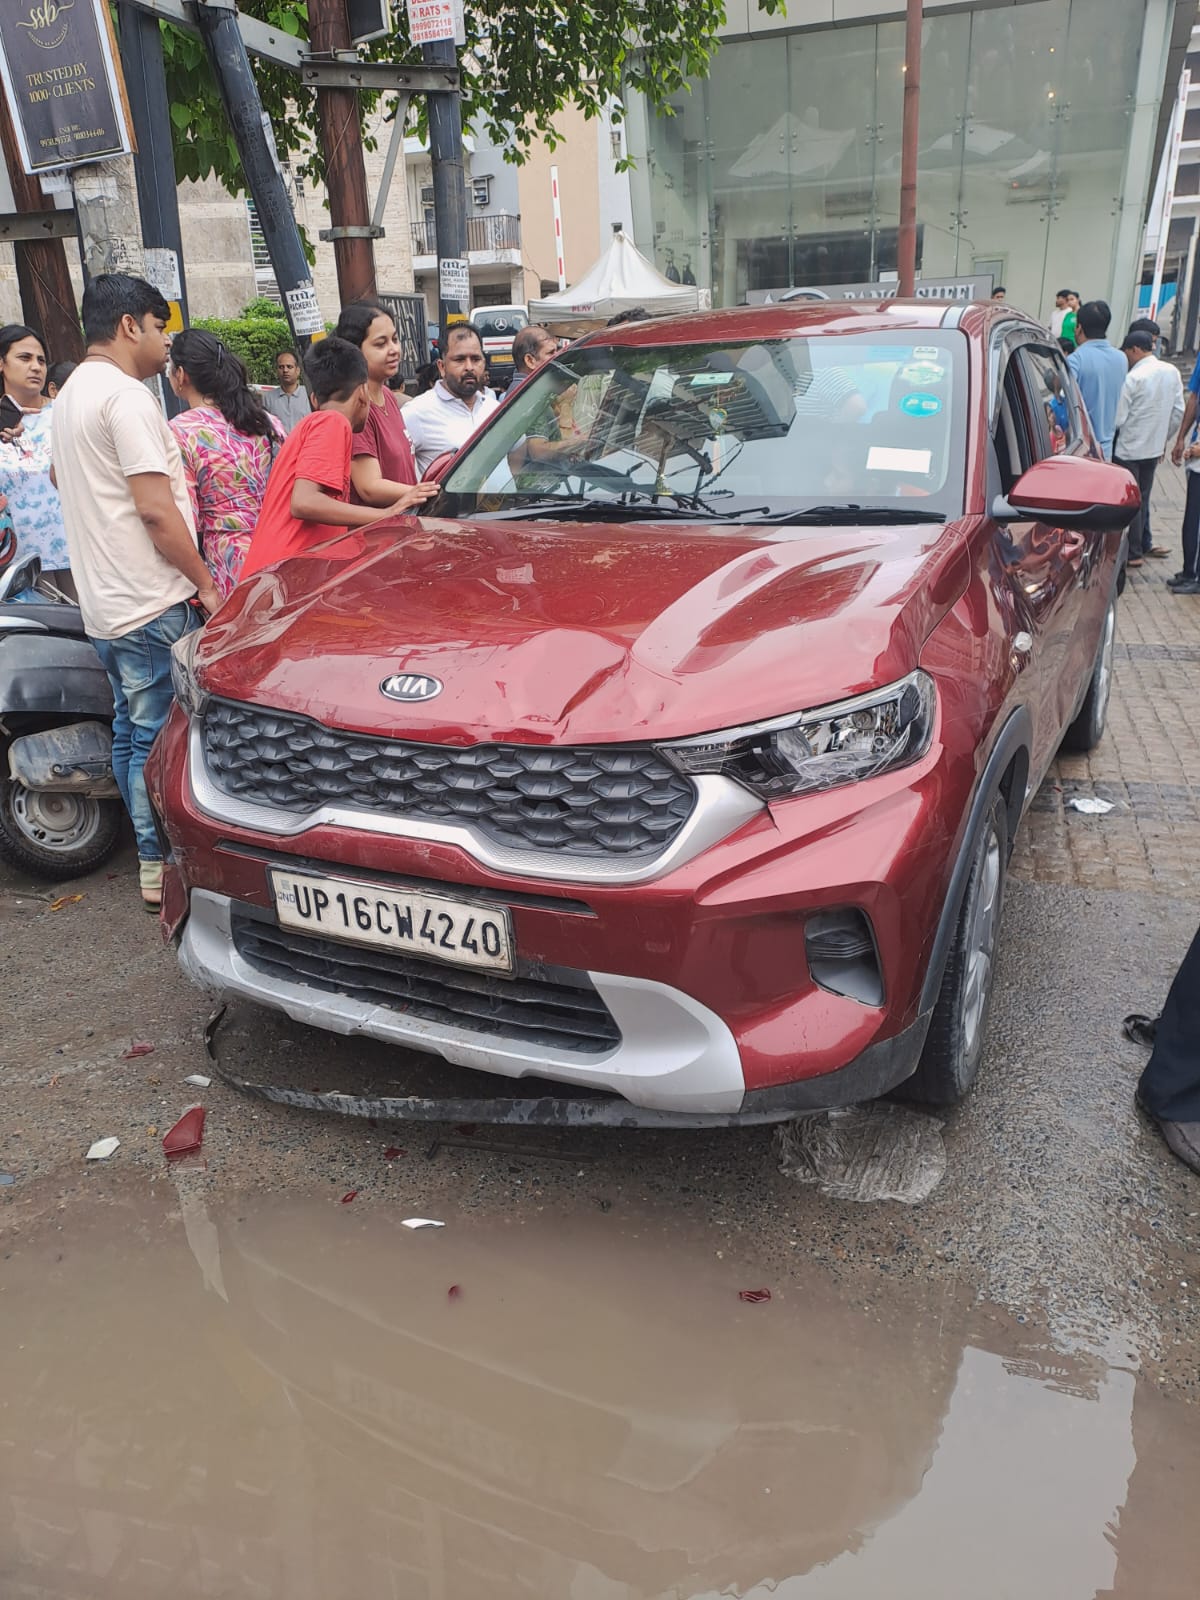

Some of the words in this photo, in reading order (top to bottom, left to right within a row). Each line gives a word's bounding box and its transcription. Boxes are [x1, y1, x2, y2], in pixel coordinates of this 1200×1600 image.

[418, 5, 440, 17] RATS
[25, 65, 72, 87] TRUSTED
[73, 62, 88, 77] BY
[52, 77, 96, 98] CLIENTS
[386, 675, 428, 695] KIA
